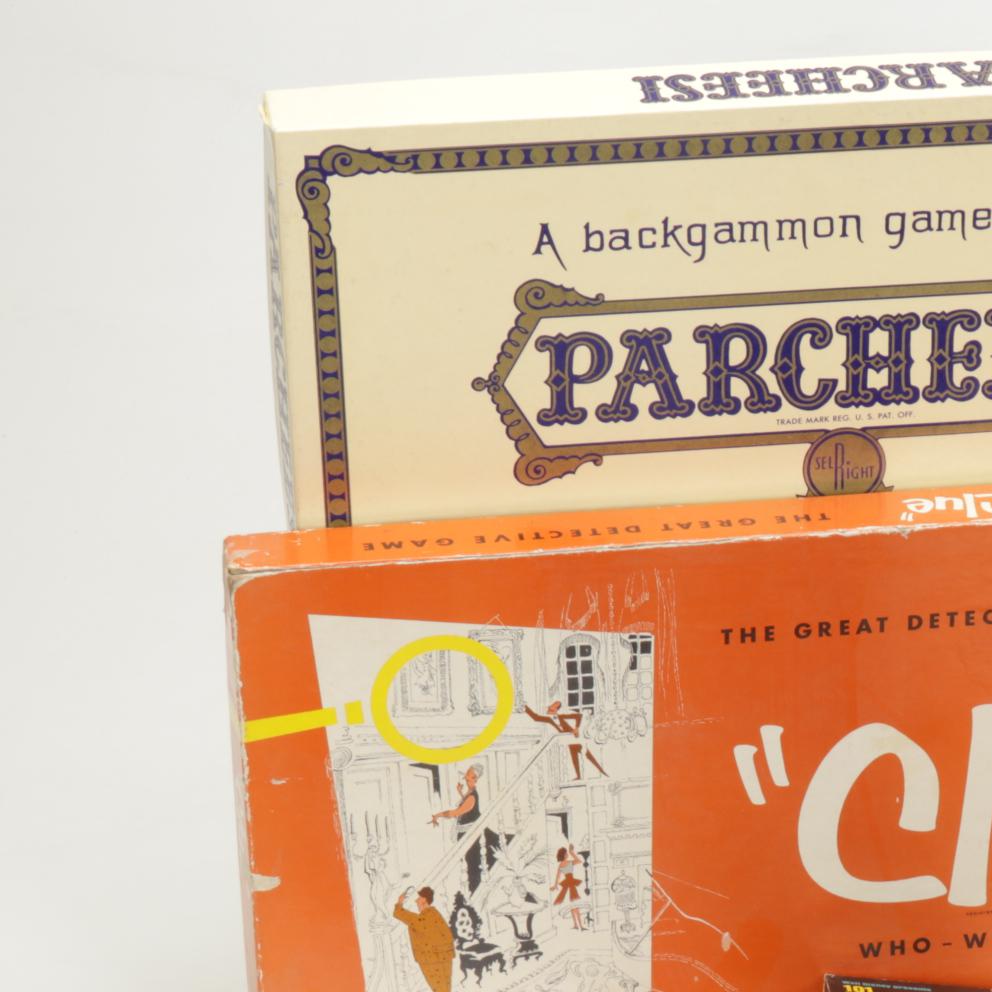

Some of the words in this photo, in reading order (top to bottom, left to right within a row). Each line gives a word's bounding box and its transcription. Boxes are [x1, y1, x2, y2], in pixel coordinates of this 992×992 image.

[532, 223, 566, 271] A
[582, 215, 862, 263] backgammon
[884, 206, 992, 249] game
[776, 418, 801, 426] TRADE
[806, 416, 829, 424] MARK
[660, 517, 756, 532] GREAT
[774, 512, 831, 524] THE
[474, 523, 641, 545] DETECTIVE
[362, 538, 455, 552] GAME
[721, 625, 775, 645] THE
[794, 616, 889, 640] GREAT
[859, 937, 931, 959] WHO
